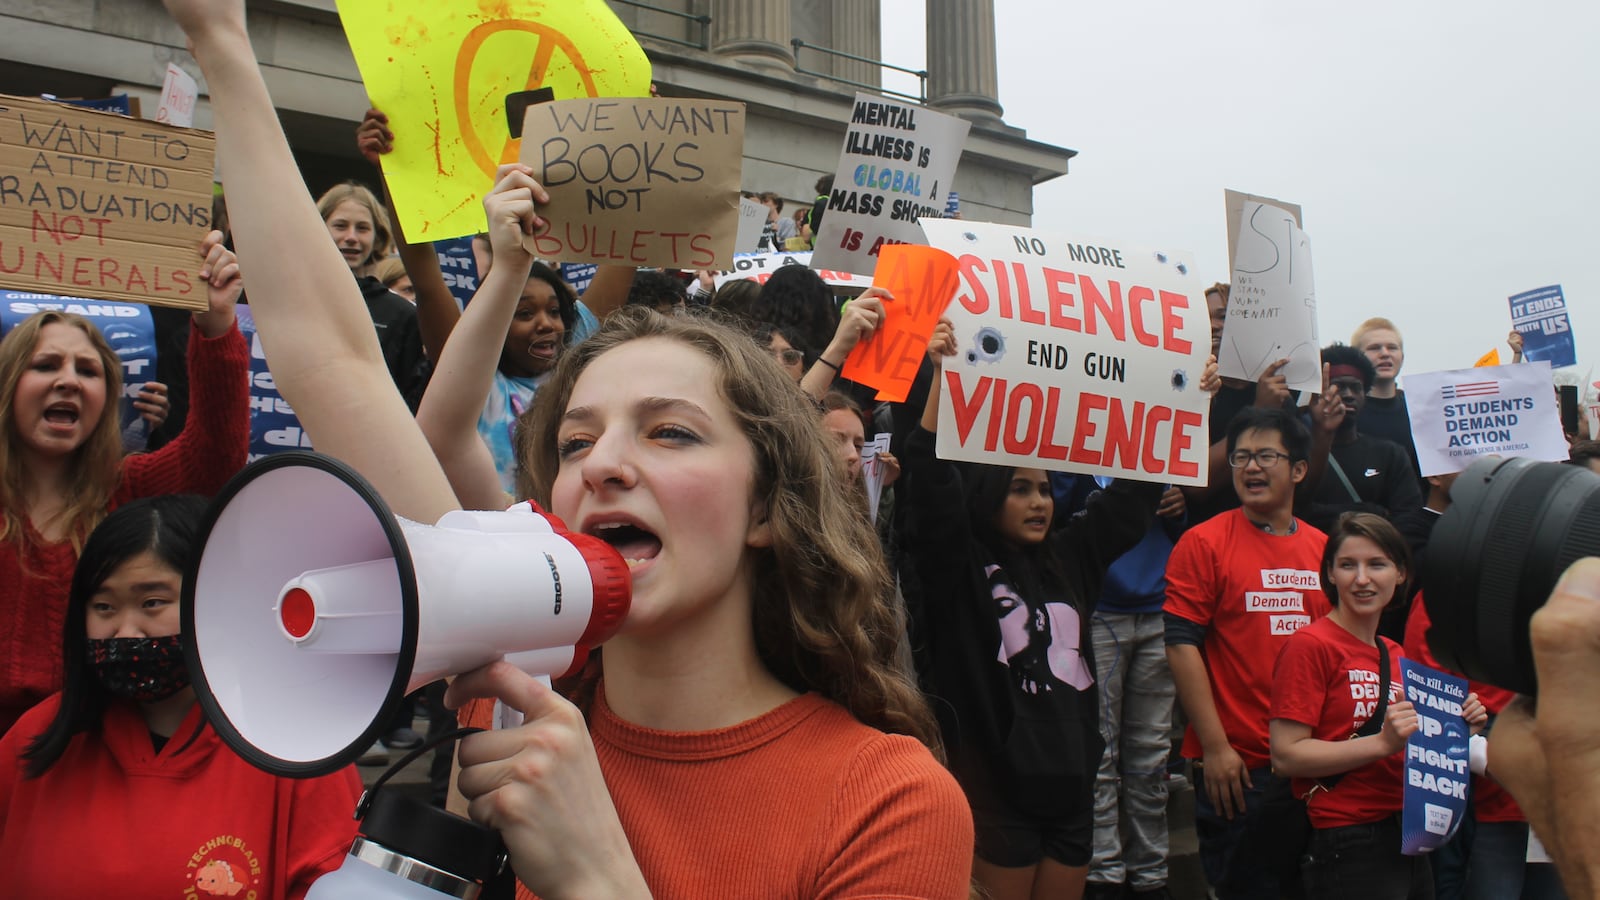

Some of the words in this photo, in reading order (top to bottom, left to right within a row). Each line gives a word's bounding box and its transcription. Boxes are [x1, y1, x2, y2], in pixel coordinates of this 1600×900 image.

[549, 103, 619, 132] WE
[633, 105, 739, 136] WANT
[852, 101, 916, 131] MENTAL
[20, 113, 125, 157] WANT
[142, 133, 189, 160] TO
[845, 131, 915, 162] ILLNESS
[917, 146, 930, 169] IS
[30, 151, 169, 189] ATTEND
[541, 137, 704, 187] BOOKS
[853, 163, 921, 197] GLOBAL
[585, 186, 651, 214] NOT
[828, 189, 884, 217] MASS
[31, 209, 112, 246] NOT
[532, 216, 715, 267] BULLETS
[840, 227, 863, 252] IS
[1013, 235, 1047, 257] NO
[1067, 242, 1126, 269] MORE
[9, 302, 141, 317] STAND
[957, 253, 1193, 355] SILENCE
[1512, 303, 1525, 318] IT
[1526, 295, 1564, 315] ENDS
[1540, 314, 1569, 336] US
[1027, 340, 1069, 370] END
[1084, 351, 1126, 383] GUN
[1443, 396, 1534, 418] STUDENTS
[944, 369, 1203, 479] VIOLENCE
[1446, 414, 1519, 433] DEMAND
[1448, 429, 1511, 448] ACTION
[1449, 449, 1463, 457] FOR
[1464, 447, 1477, 456] GUN
[1502, 443, 1529, 452] AMERICA
[543, 551, 562, 616] GROOVE
[1268, 571, 1317, 586] Students
[1406, 669, 1426, 686] Guns.
[1426, 677, 1443, 692] Kill.
[1443, 683, 1465, 699] Kids.
[1407, 685, 1463, 717] STAND
[1407, 743, 1467, 775] FIGHT
[1408, 767, 1467, 800] BACK
[187, 835, 261, 876] TECHNOBLADE
